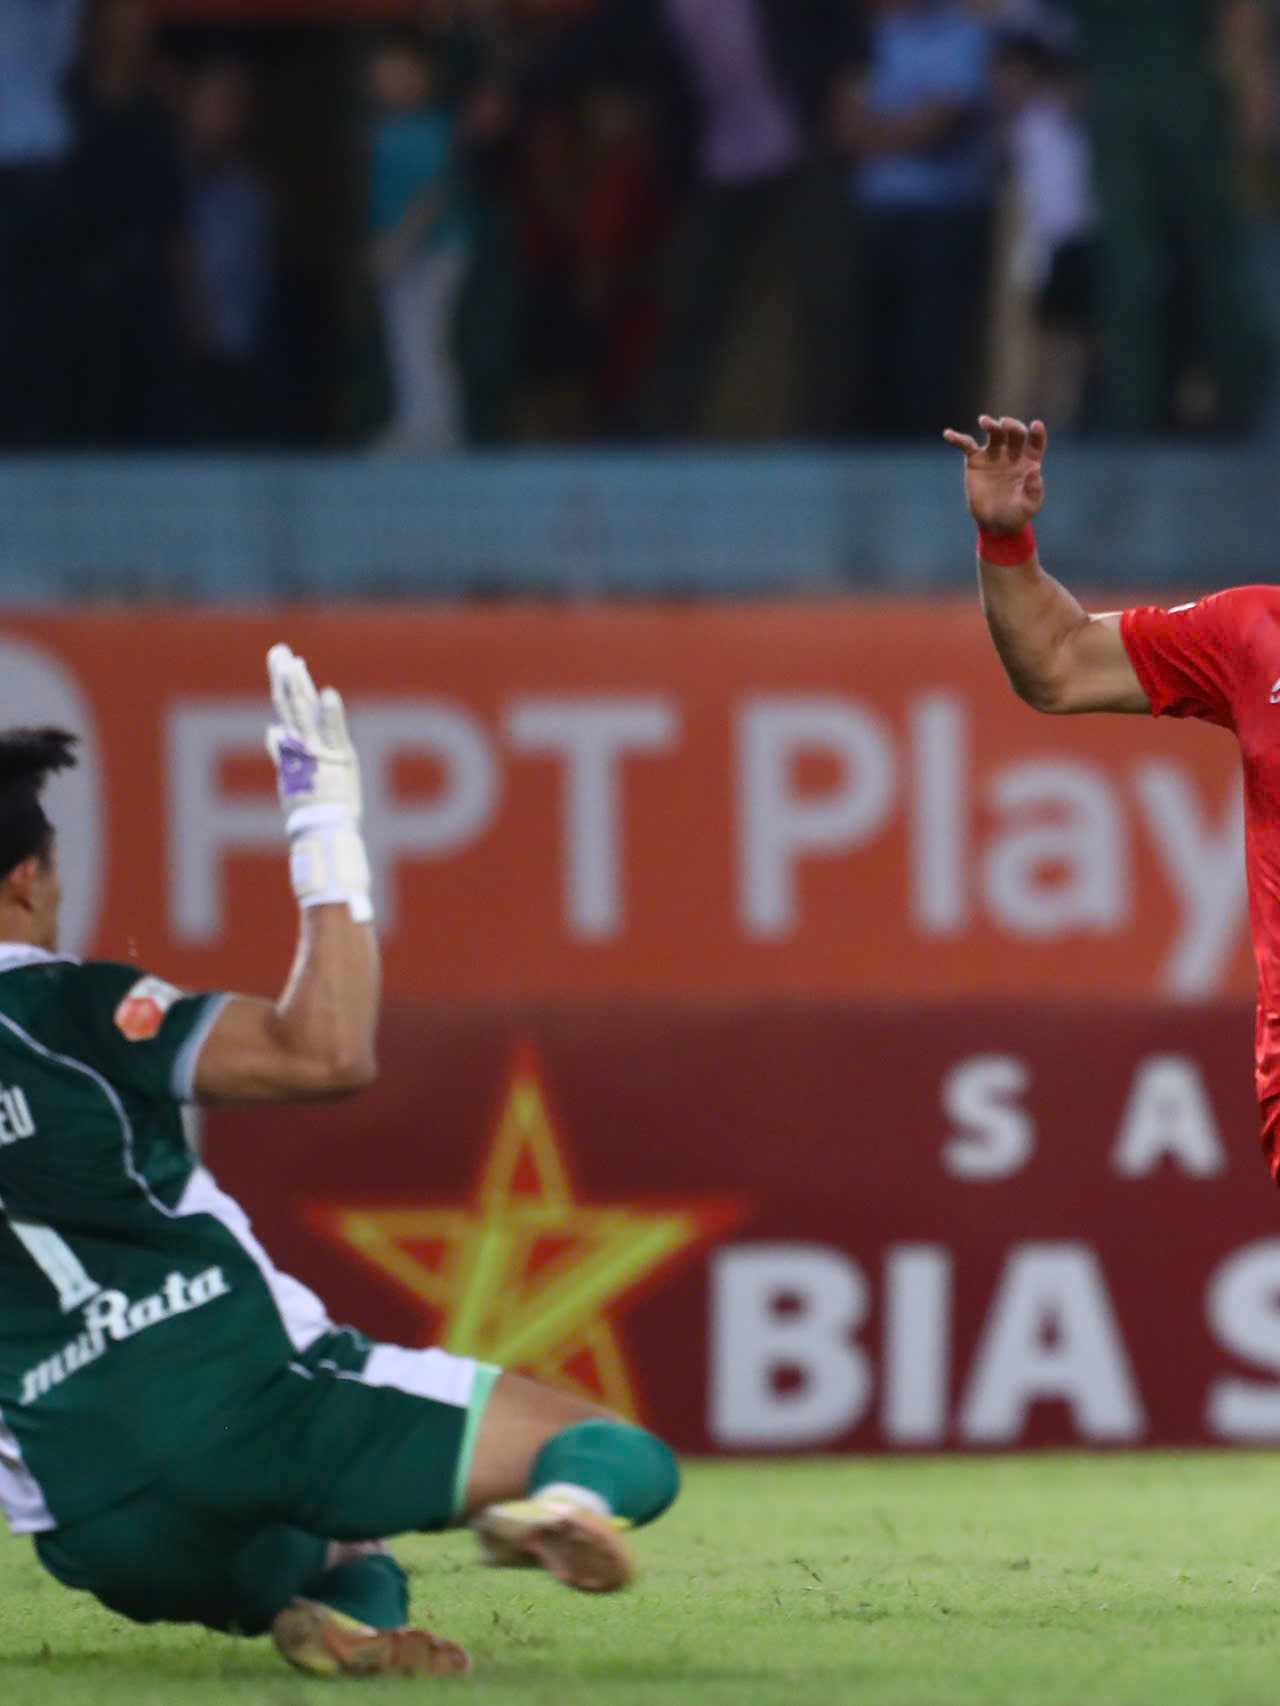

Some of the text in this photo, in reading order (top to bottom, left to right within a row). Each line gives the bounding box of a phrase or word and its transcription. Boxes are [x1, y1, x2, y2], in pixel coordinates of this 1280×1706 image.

[163, 690, 1248, 1002] FPT Play
[707, 1240, 1145, 1446] BIA
